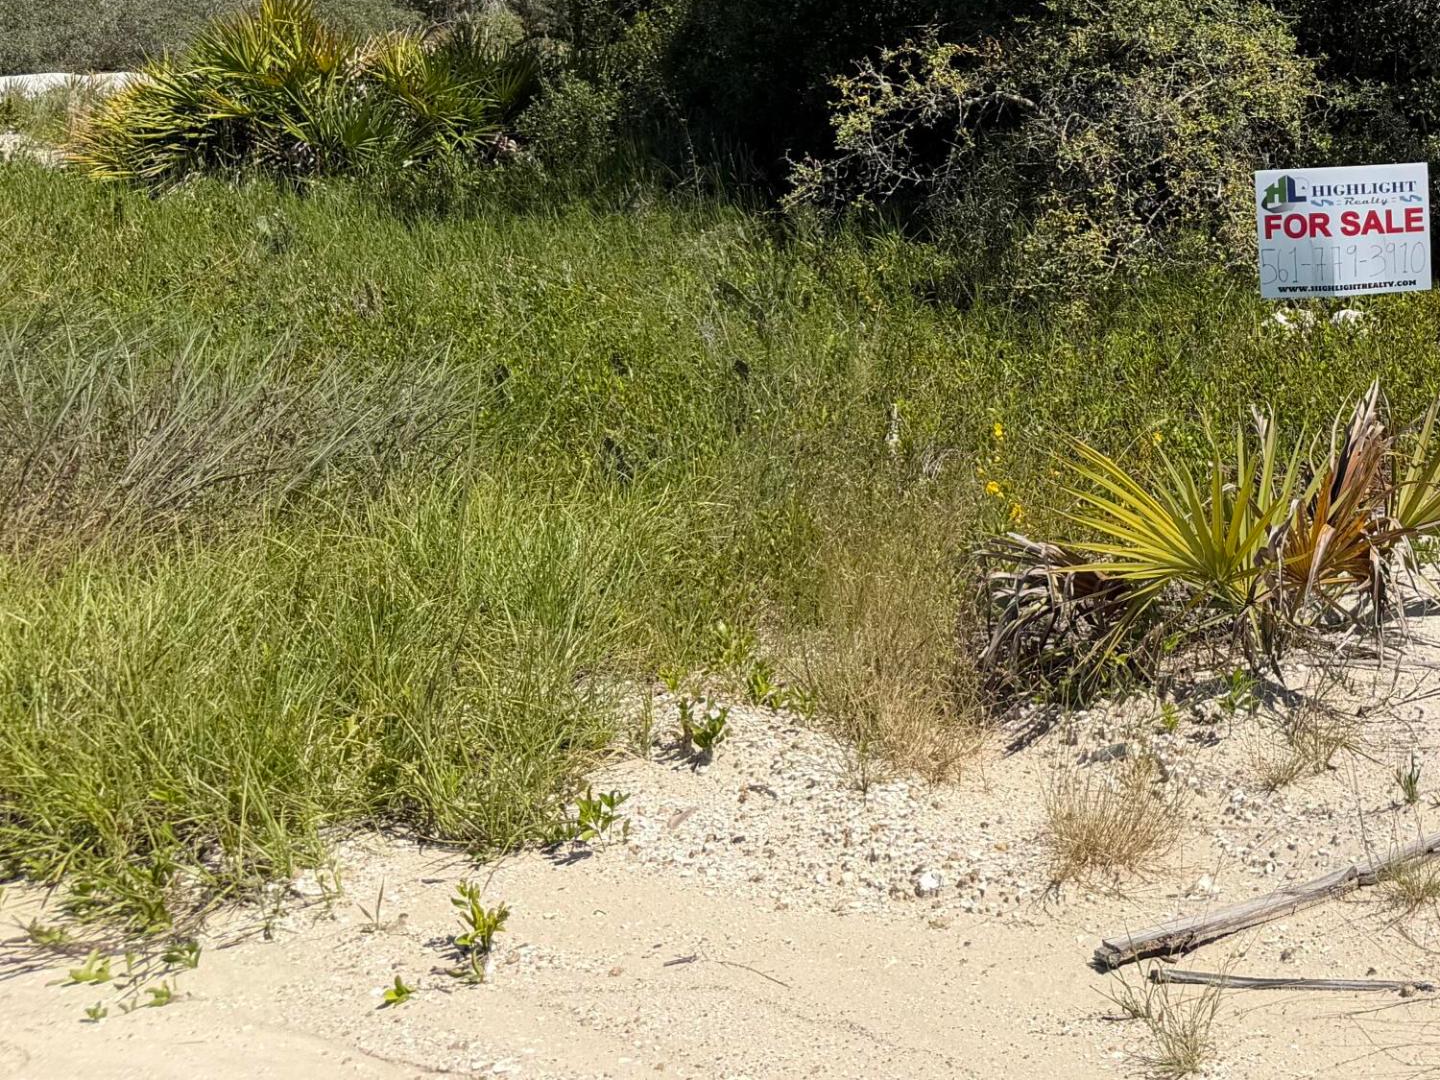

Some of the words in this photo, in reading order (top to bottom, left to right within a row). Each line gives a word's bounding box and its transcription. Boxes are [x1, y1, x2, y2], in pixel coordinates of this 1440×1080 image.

[1312, 181, 1417, 197] HIGHLIGHT
[1344, 196, 1388, 205] Realty
[1264, 212, 1332, 239] FOR
[1340, 207, 1424, 236] SALE
[1261, 242, 1426, 285] 561-779-3910
[1278, 280, 1417, 293] WWW.HIGHLIGHTREALTY.COM
